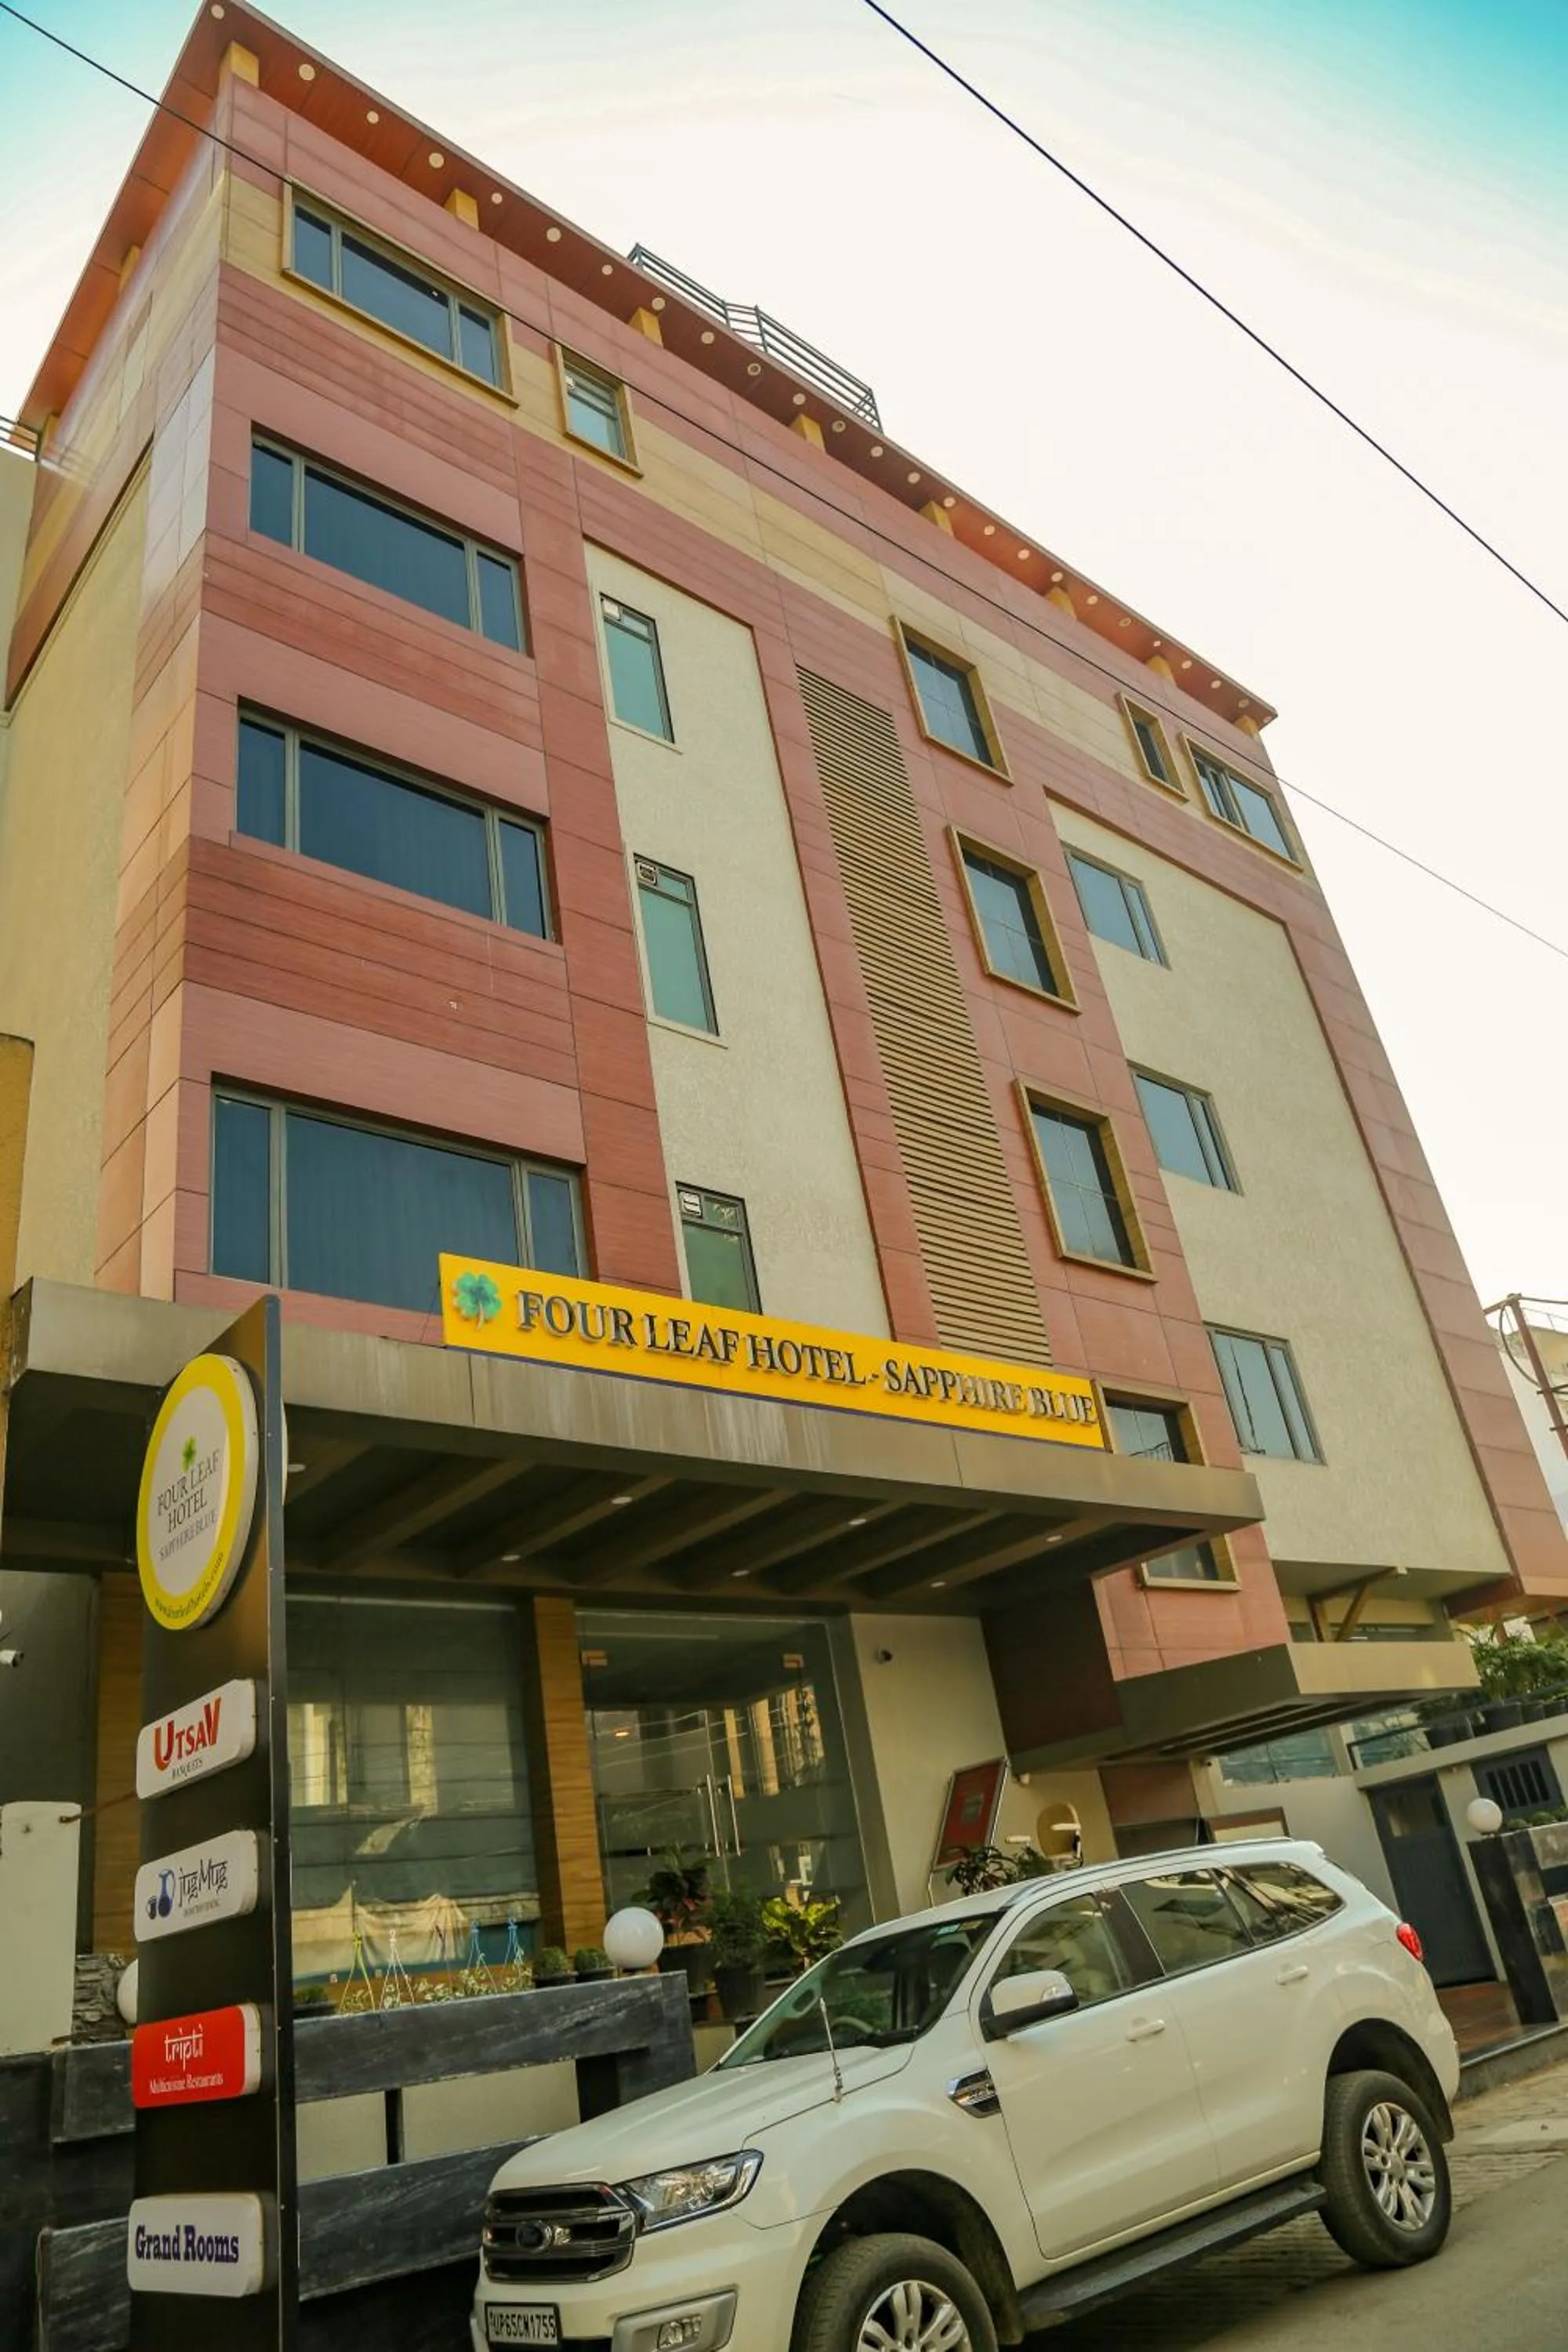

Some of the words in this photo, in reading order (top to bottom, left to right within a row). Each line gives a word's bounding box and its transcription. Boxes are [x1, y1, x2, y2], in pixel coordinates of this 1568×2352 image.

[517, 1290, 637, 1348] FOUR
[642, 1312, 739, 1364] LEAF
[746, 1334, 866, 1387] HOTEL
[884, 1359, 1026, 1414] SAPPHIRE
[1027, 1386, 1098, 1426] BLUE
[157, 1475, 188, 1516] FOUR
[191, 1449, 220, 1489] LEAF
[167, 1487, 208, 1533] HOTEL
[164, 2023, 203, 2071] tripti
[136, 2224, 181, 2261] Grand
[183, 2225, 239, 2263] Rooms
